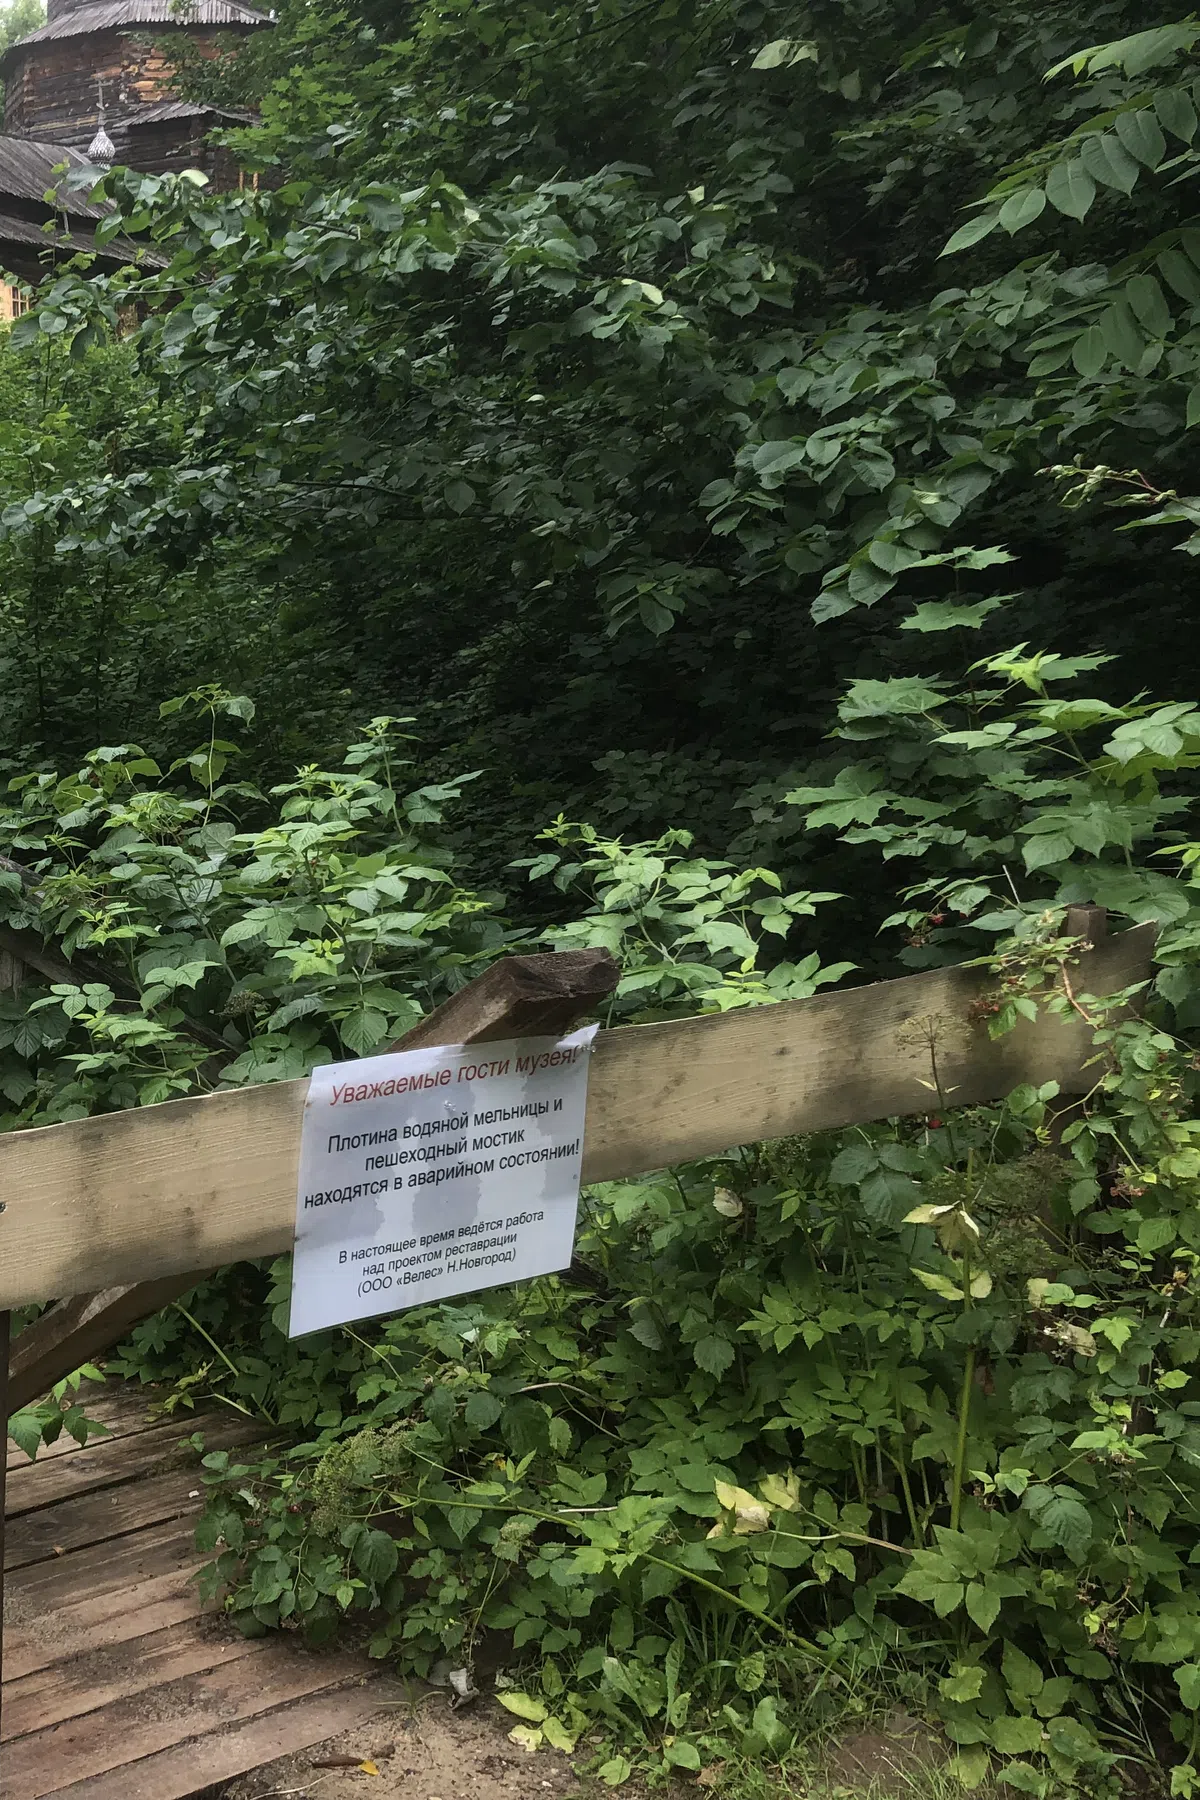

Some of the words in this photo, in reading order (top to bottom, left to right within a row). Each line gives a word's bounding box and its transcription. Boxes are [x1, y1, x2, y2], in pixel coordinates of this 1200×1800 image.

[328, 1069, 452, 1107] Уважаемые
[457, 1057, 510, 1082] гости
[514, 1045, 579, 1076] музея!
[327, 1129, 398, 1154] Плотина
[402, 1111, 469, 1141] водяной
[473, 1098, 550, 1127] мельницы
[553, 1097, 563, 1112] и
[365, 1137, 468, 1171] пешеходный
[472, 1127, 525, 1151] мостик
[304, 1177, 388, 1209] находятся
[393, 1176, 403, 1190] в
[407, 1160, 495, 1188] аварийном
[499, 1138, 580, 1170] состоянии!
[338, 1250, 348, 1264] В
[351, 1238, 417, 1262] настоящее
[420, 1229, 454, 1249] время
[457, 1218, 503, 1240] ведётся
[505, 1209, 544, 1231] работа
[362, 1261, 385, 1277] над
[388, 1249, 442, 1273] проектом
[445, 1233, 518, 1260] реставрации
[357, 1276, 393, 1298] (ООО
[396, 1265, 444, 1286] «Велес»
[447, 1248, 517, 1274] Н.Новгород)
